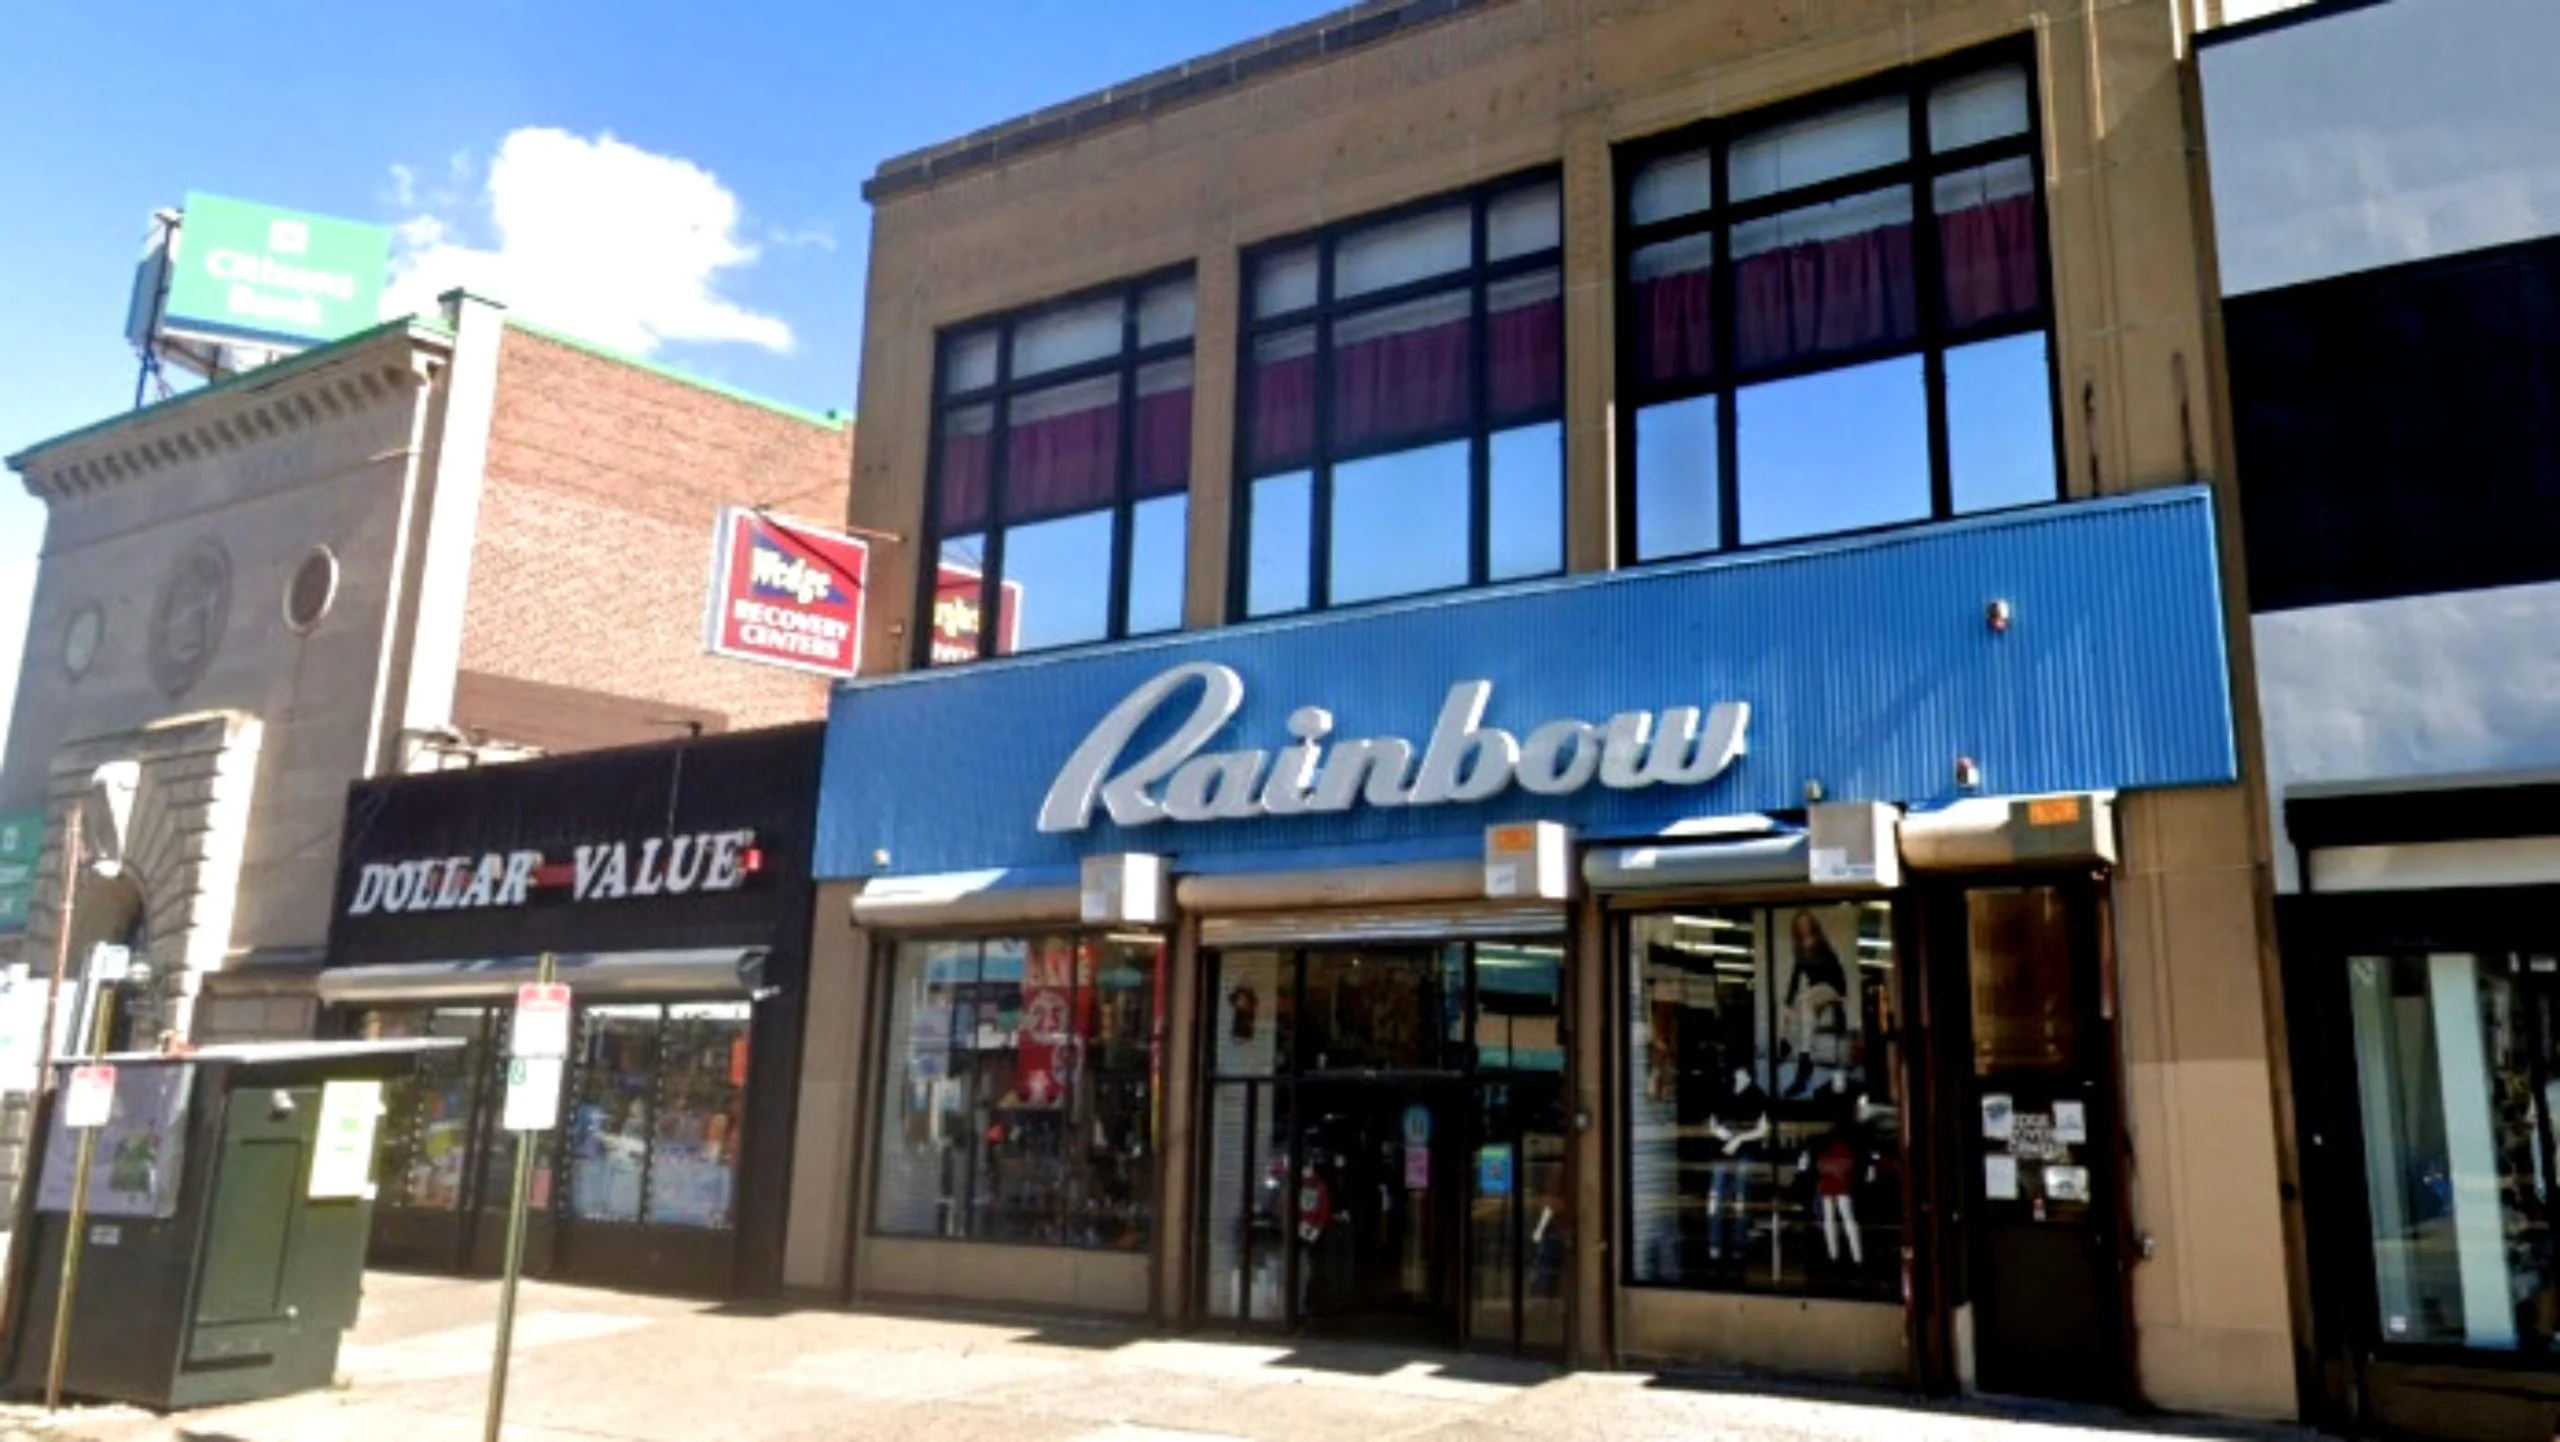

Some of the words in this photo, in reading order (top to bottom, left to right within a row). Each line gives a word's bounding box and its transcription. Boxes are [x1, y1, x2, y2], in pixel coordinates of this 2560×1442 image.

[752, 547, 833, 604] Wedge
[734, 599, 851, 641] RECOVERY
[740, 622, 841, 660] CENTERS
[1037, 660, 1750, 832] Rainbow
[349, 849, 543, 915] DOLLAR
[571, 830, 754, 901] VALUE
